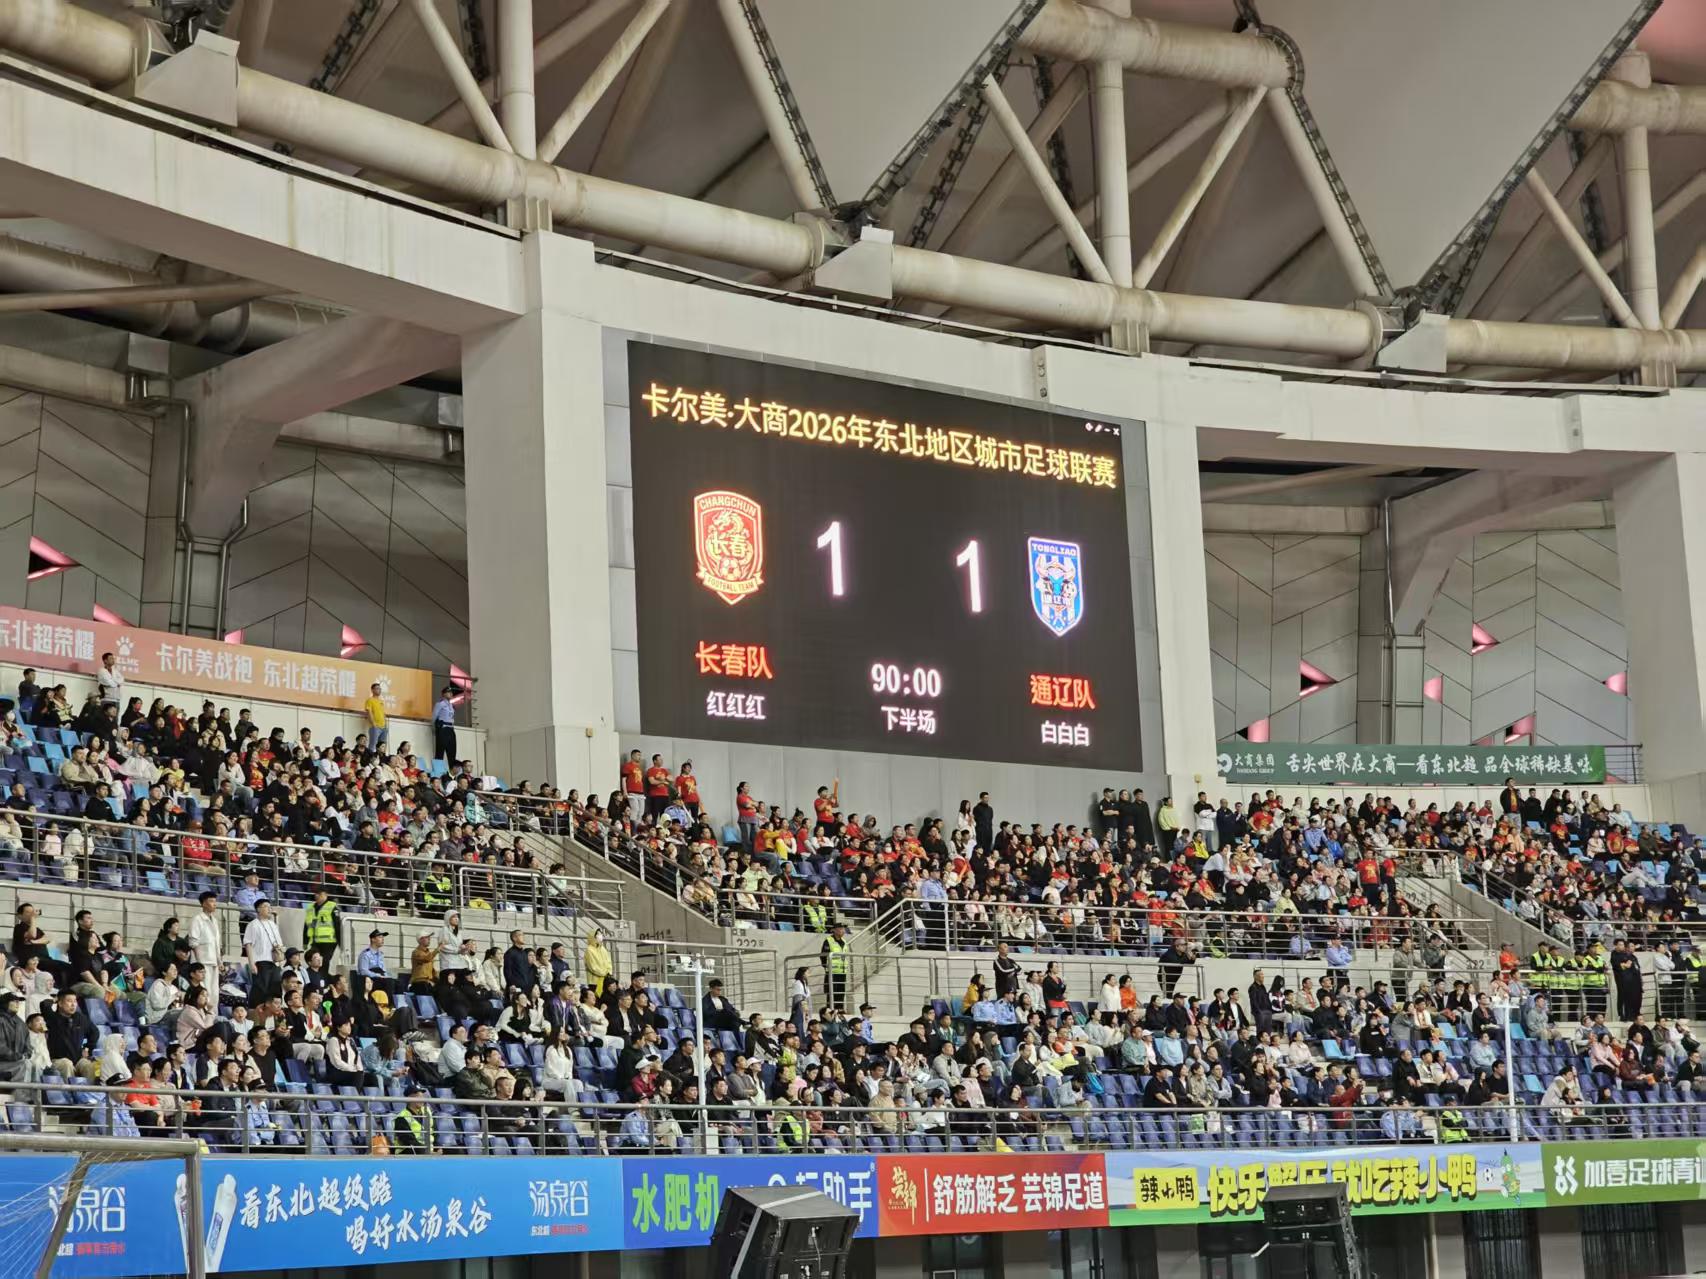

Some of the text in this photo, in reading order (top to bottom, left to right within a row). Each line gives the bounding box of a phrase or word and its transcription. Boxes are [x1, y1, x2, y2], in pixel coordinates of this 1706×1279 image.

[641, 382, 1117, 489] 卡尔美·大商2026年东北地区城市足球联赛
[700, 495, 757, 517] CHANGCHUN
[816, 521, 844, 596] 1
[1031, 542, 1077, 556] TONGLIAO
[956, 539, 982, 612] 1
[155, 643, 253, 684] 卡尔美战袍
[695, 640, 773, 680] 长春队
[870, 663, 942, 698] 90:00
[1029, 674, 1096, 710] 通辽队
[705, 690, 766, 721] 红红红
[880, 704, 937, 735] 下半场
[1041, 719, 1090, 747] 白白白
[239, 1170, 393, 1229] 看东北超级酷
[932, 1171, 1105, 1216] 舒筋解乏 芸锦足道
[1139, 1174, 1196, 1203] 辣小鸭
[345, 1196, 493, 1255] 喝好水汤泉谷
